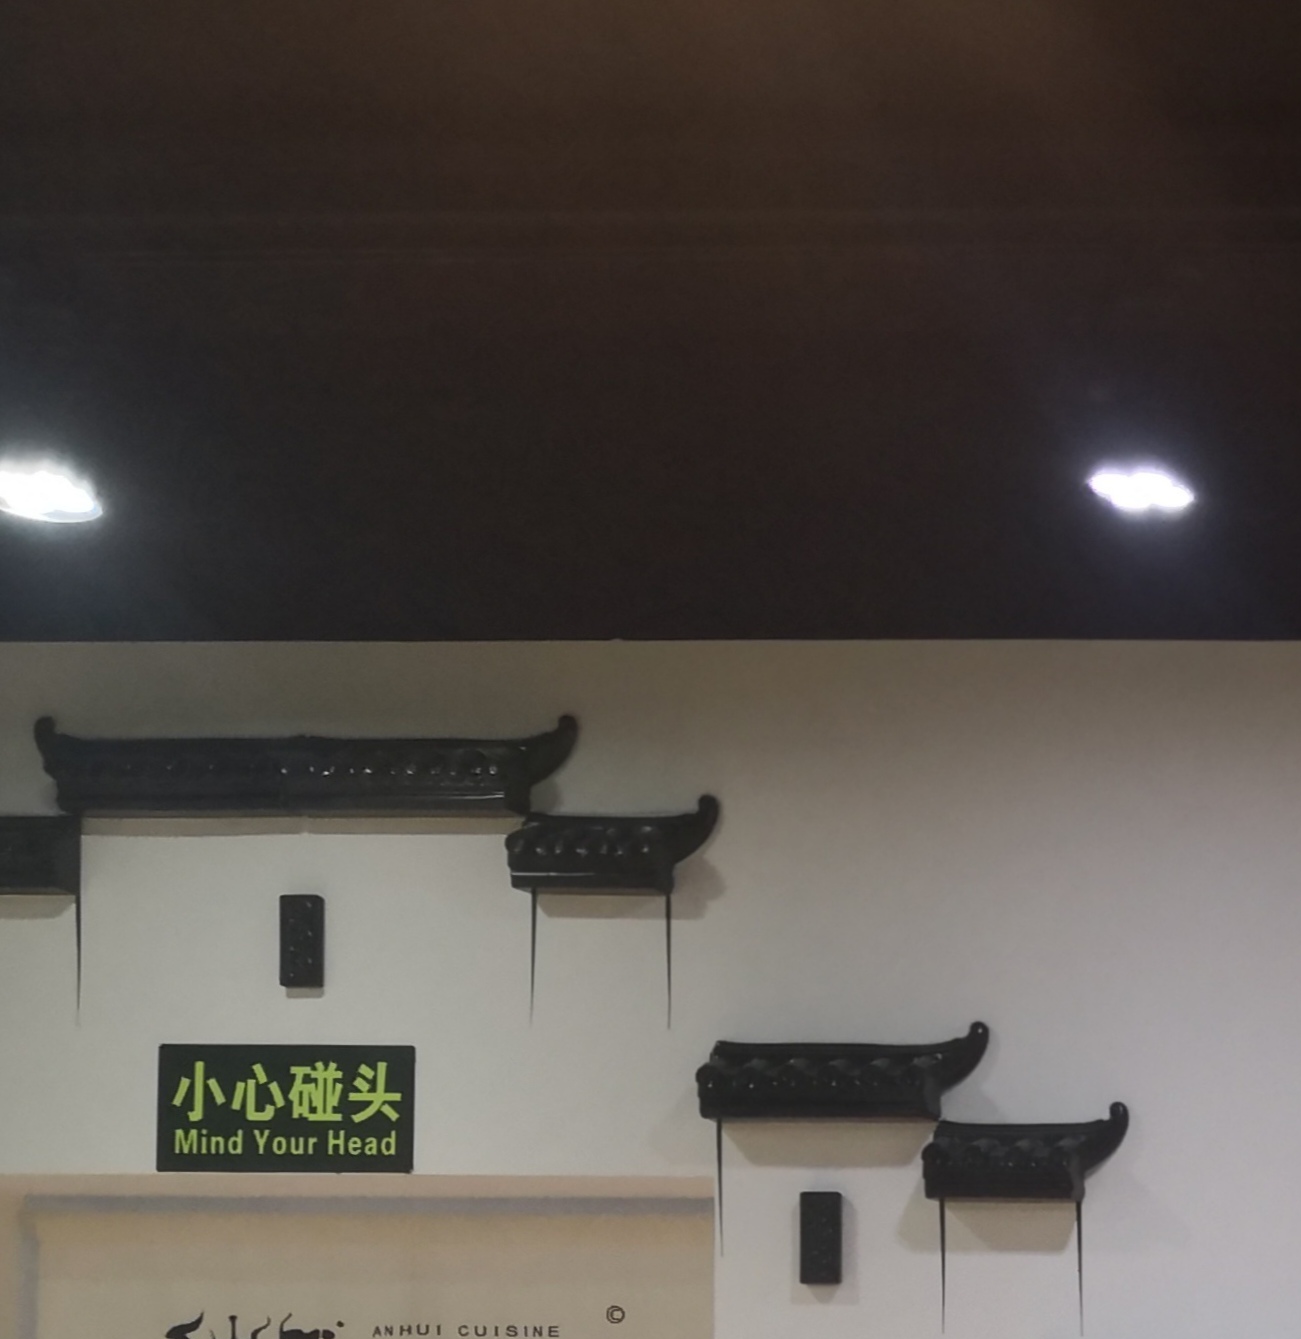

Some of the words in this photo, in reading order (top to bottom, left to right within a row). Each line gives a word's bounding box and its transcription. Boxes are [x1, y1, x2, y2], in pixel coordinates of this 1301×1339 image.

[171, 1060, 402, 1123] 小心碰头
[174, 1129, 244, 1155] Mind
[253, 1129, 318, 1155] Your
[327, 1129, 397, 1156] Head
[372, 1323, 442, 1338] ANHUI
[457, 1324, 560, 1338] CUISINE
